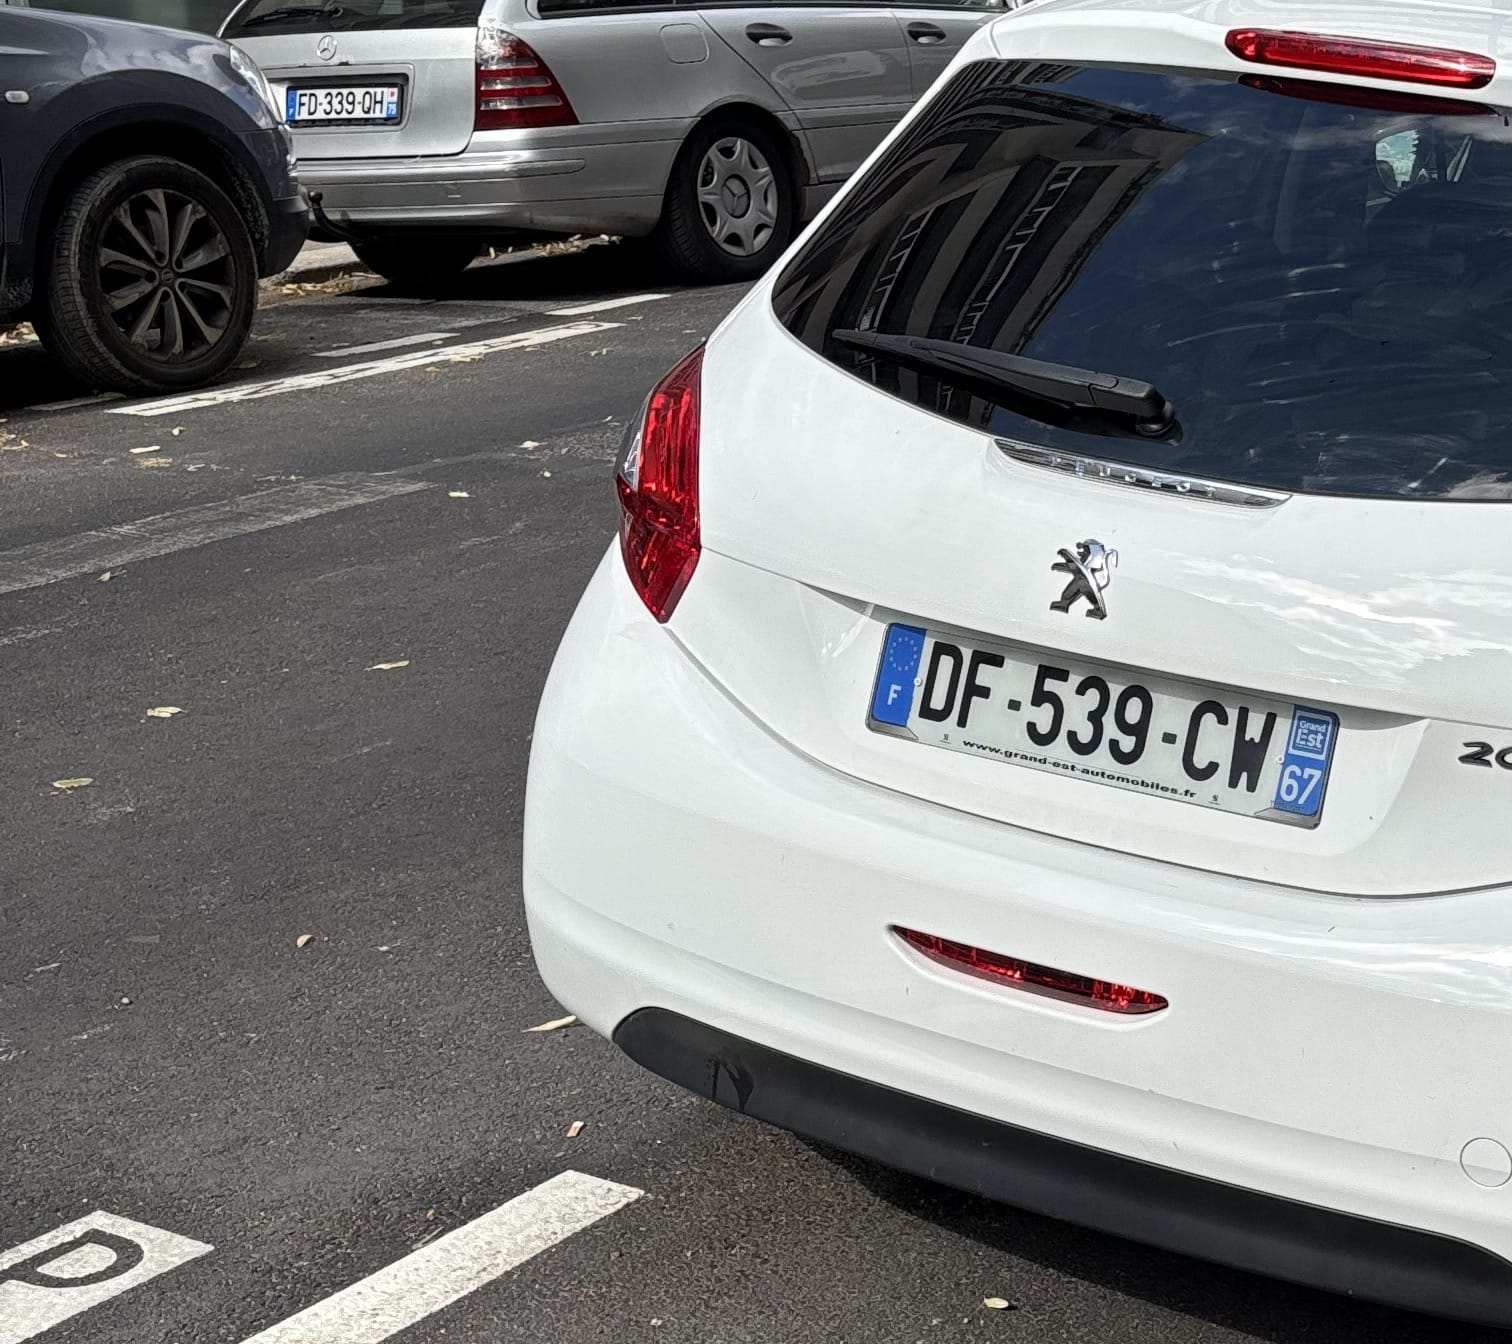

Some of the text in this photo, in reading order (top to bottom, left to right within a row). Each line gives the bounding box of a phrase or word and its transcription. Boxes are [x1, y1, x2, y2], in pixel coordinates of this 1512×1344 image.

[298, 90, 385, 116] FD-339-QH
[887, 684, 901, 705] F
[918, 640, 1278, 793] DF-539-CW
[1299, 719, 1327, 732] Grand
[1296, 729, 1324, 748] Est
[962, 739, 1197, 799] www.grand-est-automobiles.fr
[1280, 763, 1322, 805] 67
